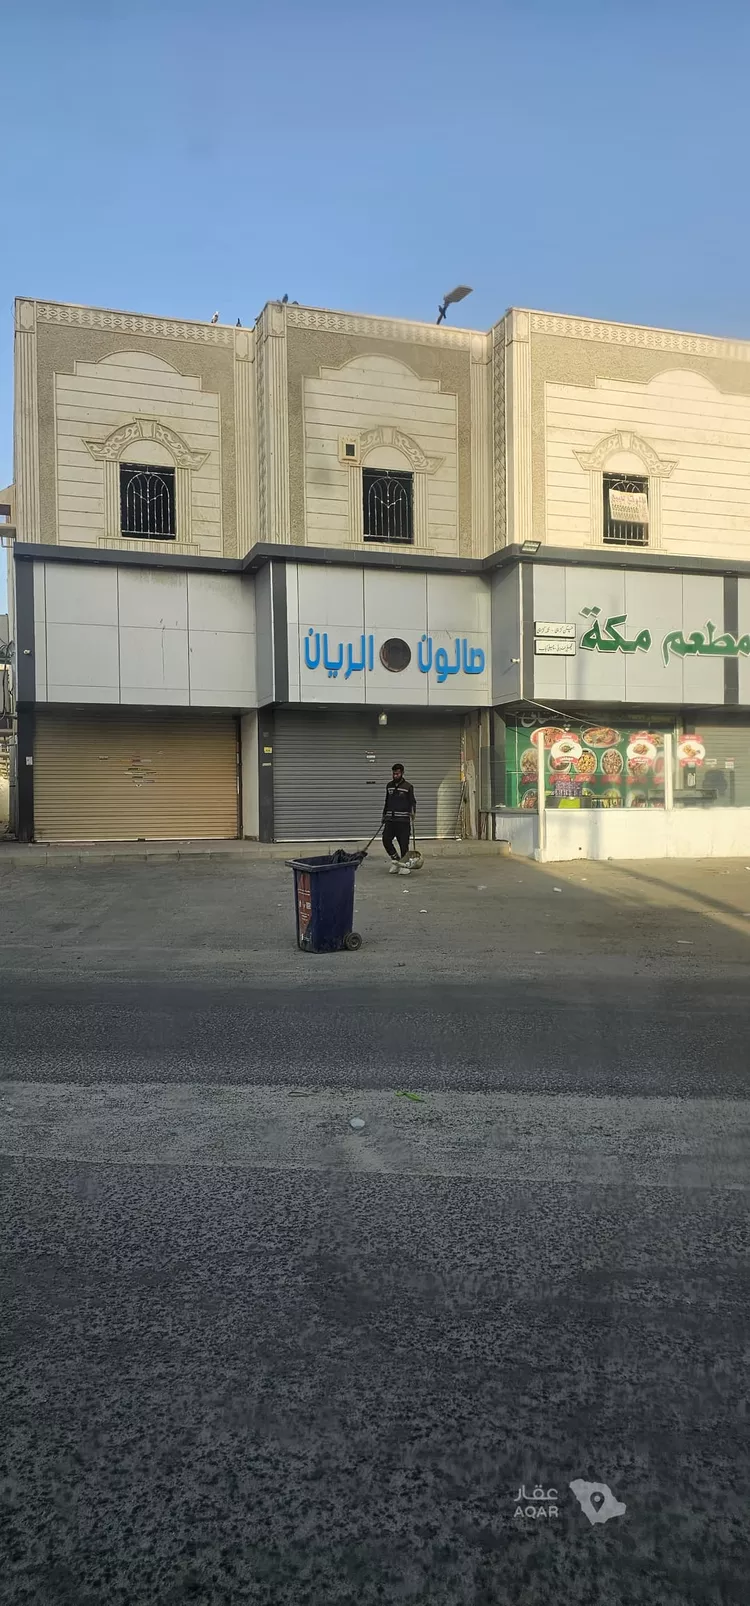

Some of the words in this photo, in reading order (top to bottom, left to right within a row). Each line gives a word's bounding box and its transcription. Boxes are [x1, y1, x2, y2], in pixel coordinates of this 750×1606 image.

[579, 604, 652, 653] مكة
[304, 627, 374, 680] الريان
[417, 634, 486, 683] صالون
